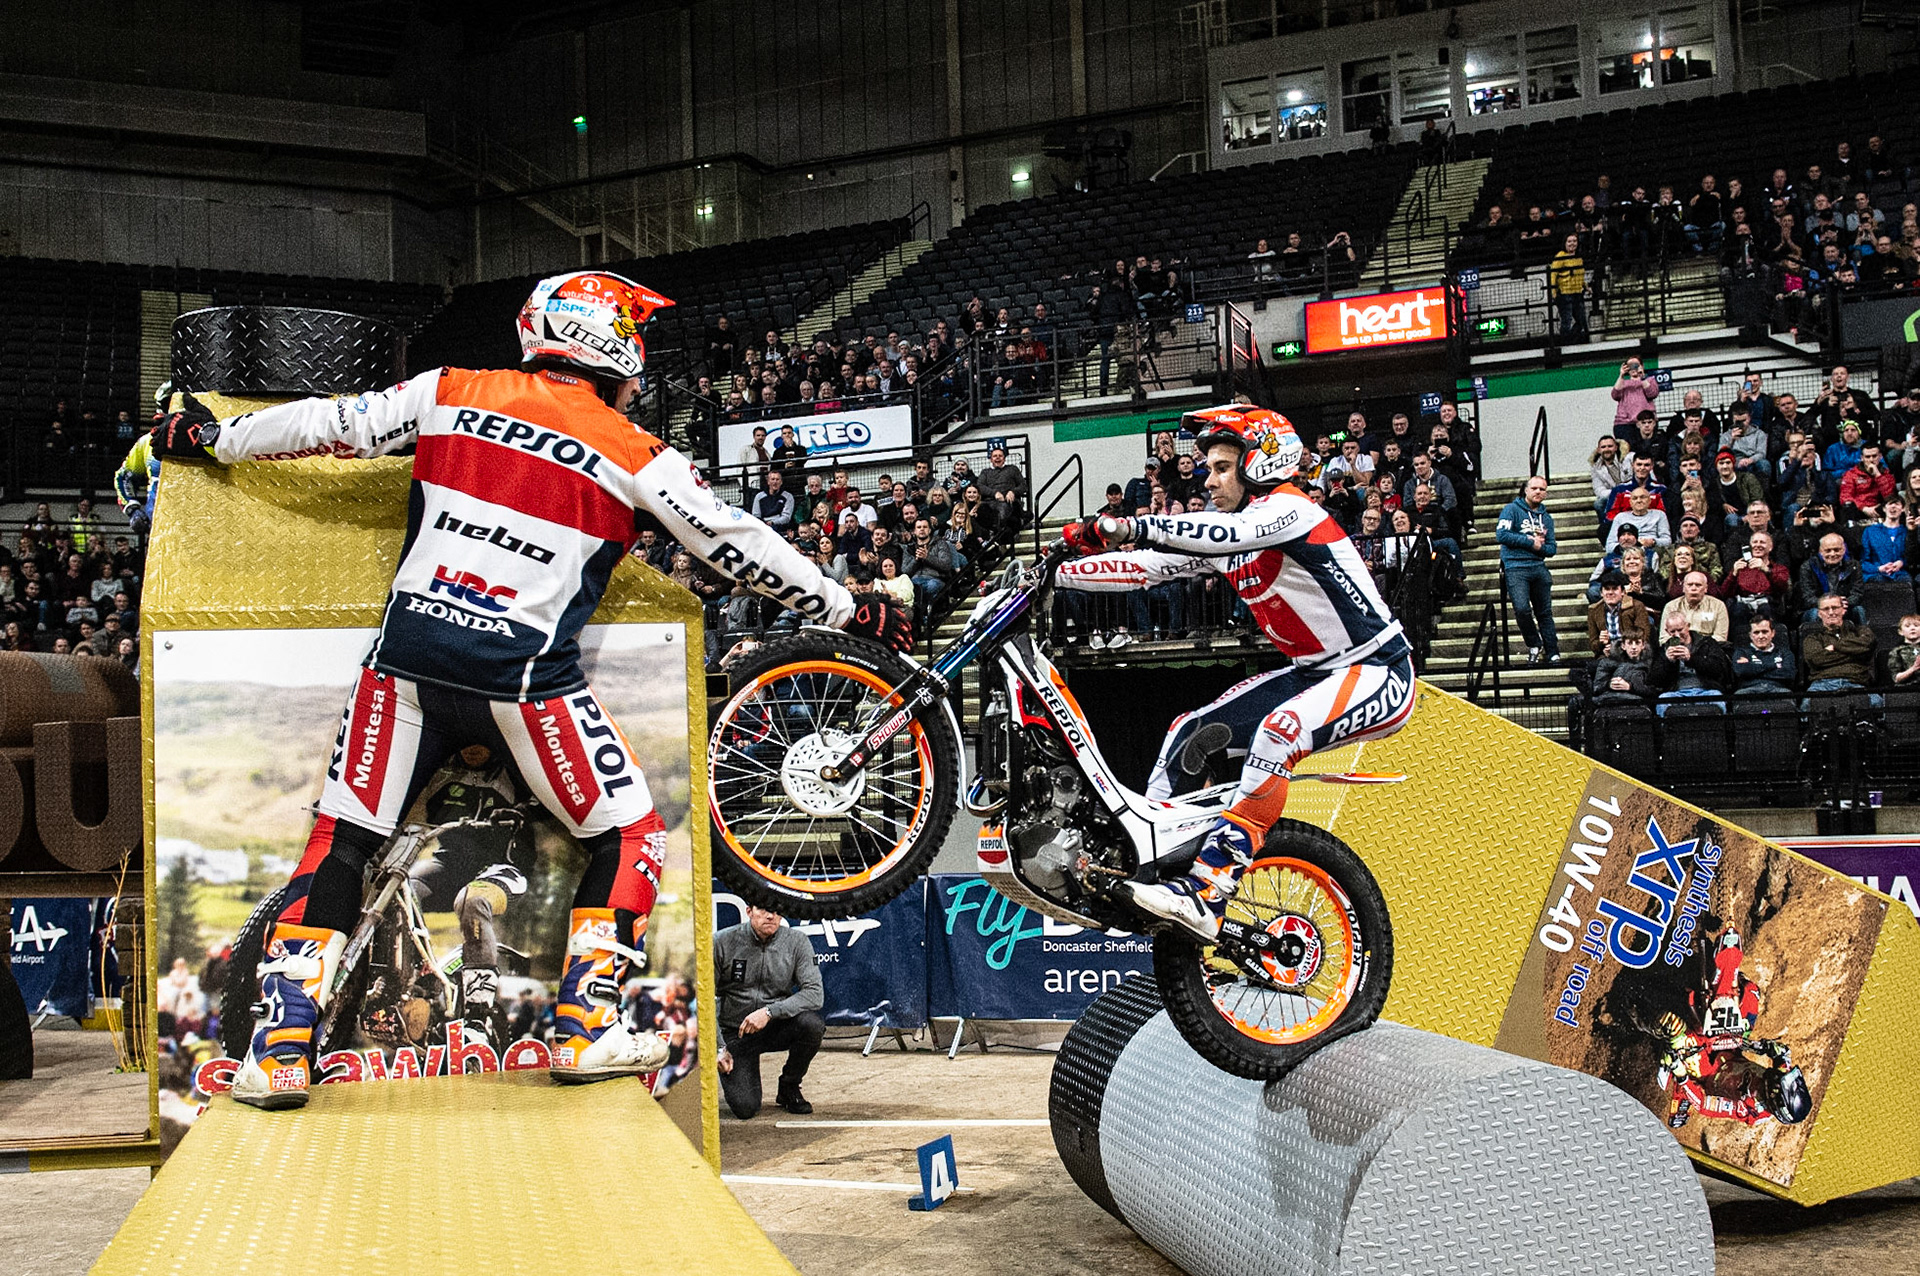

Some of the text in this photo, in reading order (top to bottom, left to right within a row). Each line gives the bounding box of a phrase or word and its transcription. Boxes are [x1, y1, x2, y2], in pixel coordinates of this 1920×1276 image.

[1460, 273, 1478, 283] 210
[1187, 307, 1203, 317] 211
[1340, 293, 1431, 335] heart
[560, 321, 638, 373] hebo
[1422, 396, 1440, 407] 110
[452, 409, 602, 479] REPSOL
[433, 510, 556, 565] hebo
[657, 490, 718, 539] hebo
[1256, 510, 1299, 539] hebo
[429, 564, 518, 613] HRC
[1322, 560, 1370, 617] HONDA
[405, 596, 516, 638] HONDA
[870, 710, 908, 750] SHOWA
[1037, 685, 1086, 753] REPSOL
[1328, 671, 1409, 743] REPSOL
[352, 689, 387, 790] Montesa
[539, 714, 587, 807] Montesa
[980, 839, 1004, 850] REPSOL
[1539, 795, 1622, 953] 10W-40
[1598, 815, 1700, 969] xrp
[945, 879, 1043, 970] Fly
[1665, 842, 1722, 967] synthesis
[1043, 940, 1101, 954] Doncaster
[1554, 918, 1608, 1028] off road
[930, 1150, 955, 1202] 4
